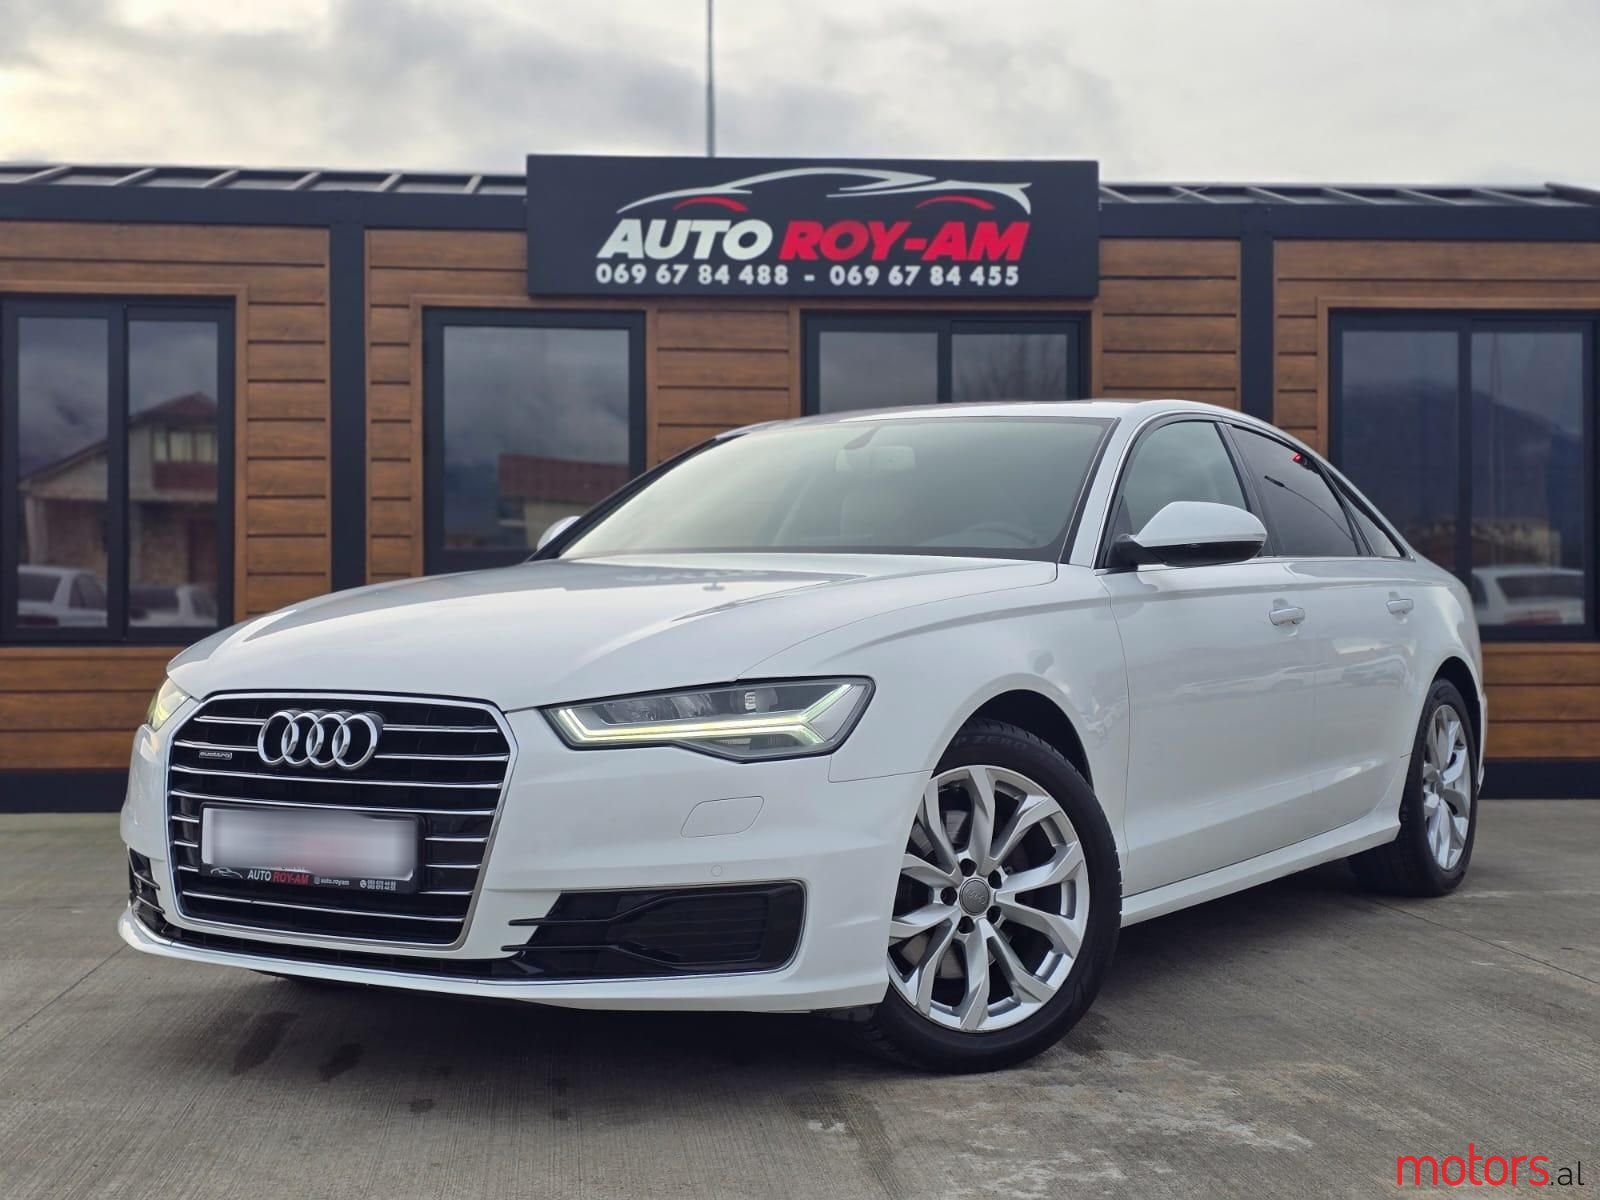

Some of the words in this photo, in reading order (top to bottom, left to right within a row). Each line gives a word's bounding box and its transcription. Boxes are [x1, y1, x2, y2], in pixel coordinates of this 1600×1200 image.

[596, 219, 773, 261] AUTO
[778, 220, 1030, 261] ROY-AM
[596, 264, 646, 284] 069
[655, 264, 689, 284] 67
[698, 265, 730, 285] 84
[738, 265, 789, 285] 488
[829, 265, 880, 286] 069
[888, 265, 919, 286] 67
[930, 266, 962, 286] 84
[969, 266, 1020, 286] 455
[247, 869, 272, 882] AUTO
[272, 871, 309, 886] ROY-AM
